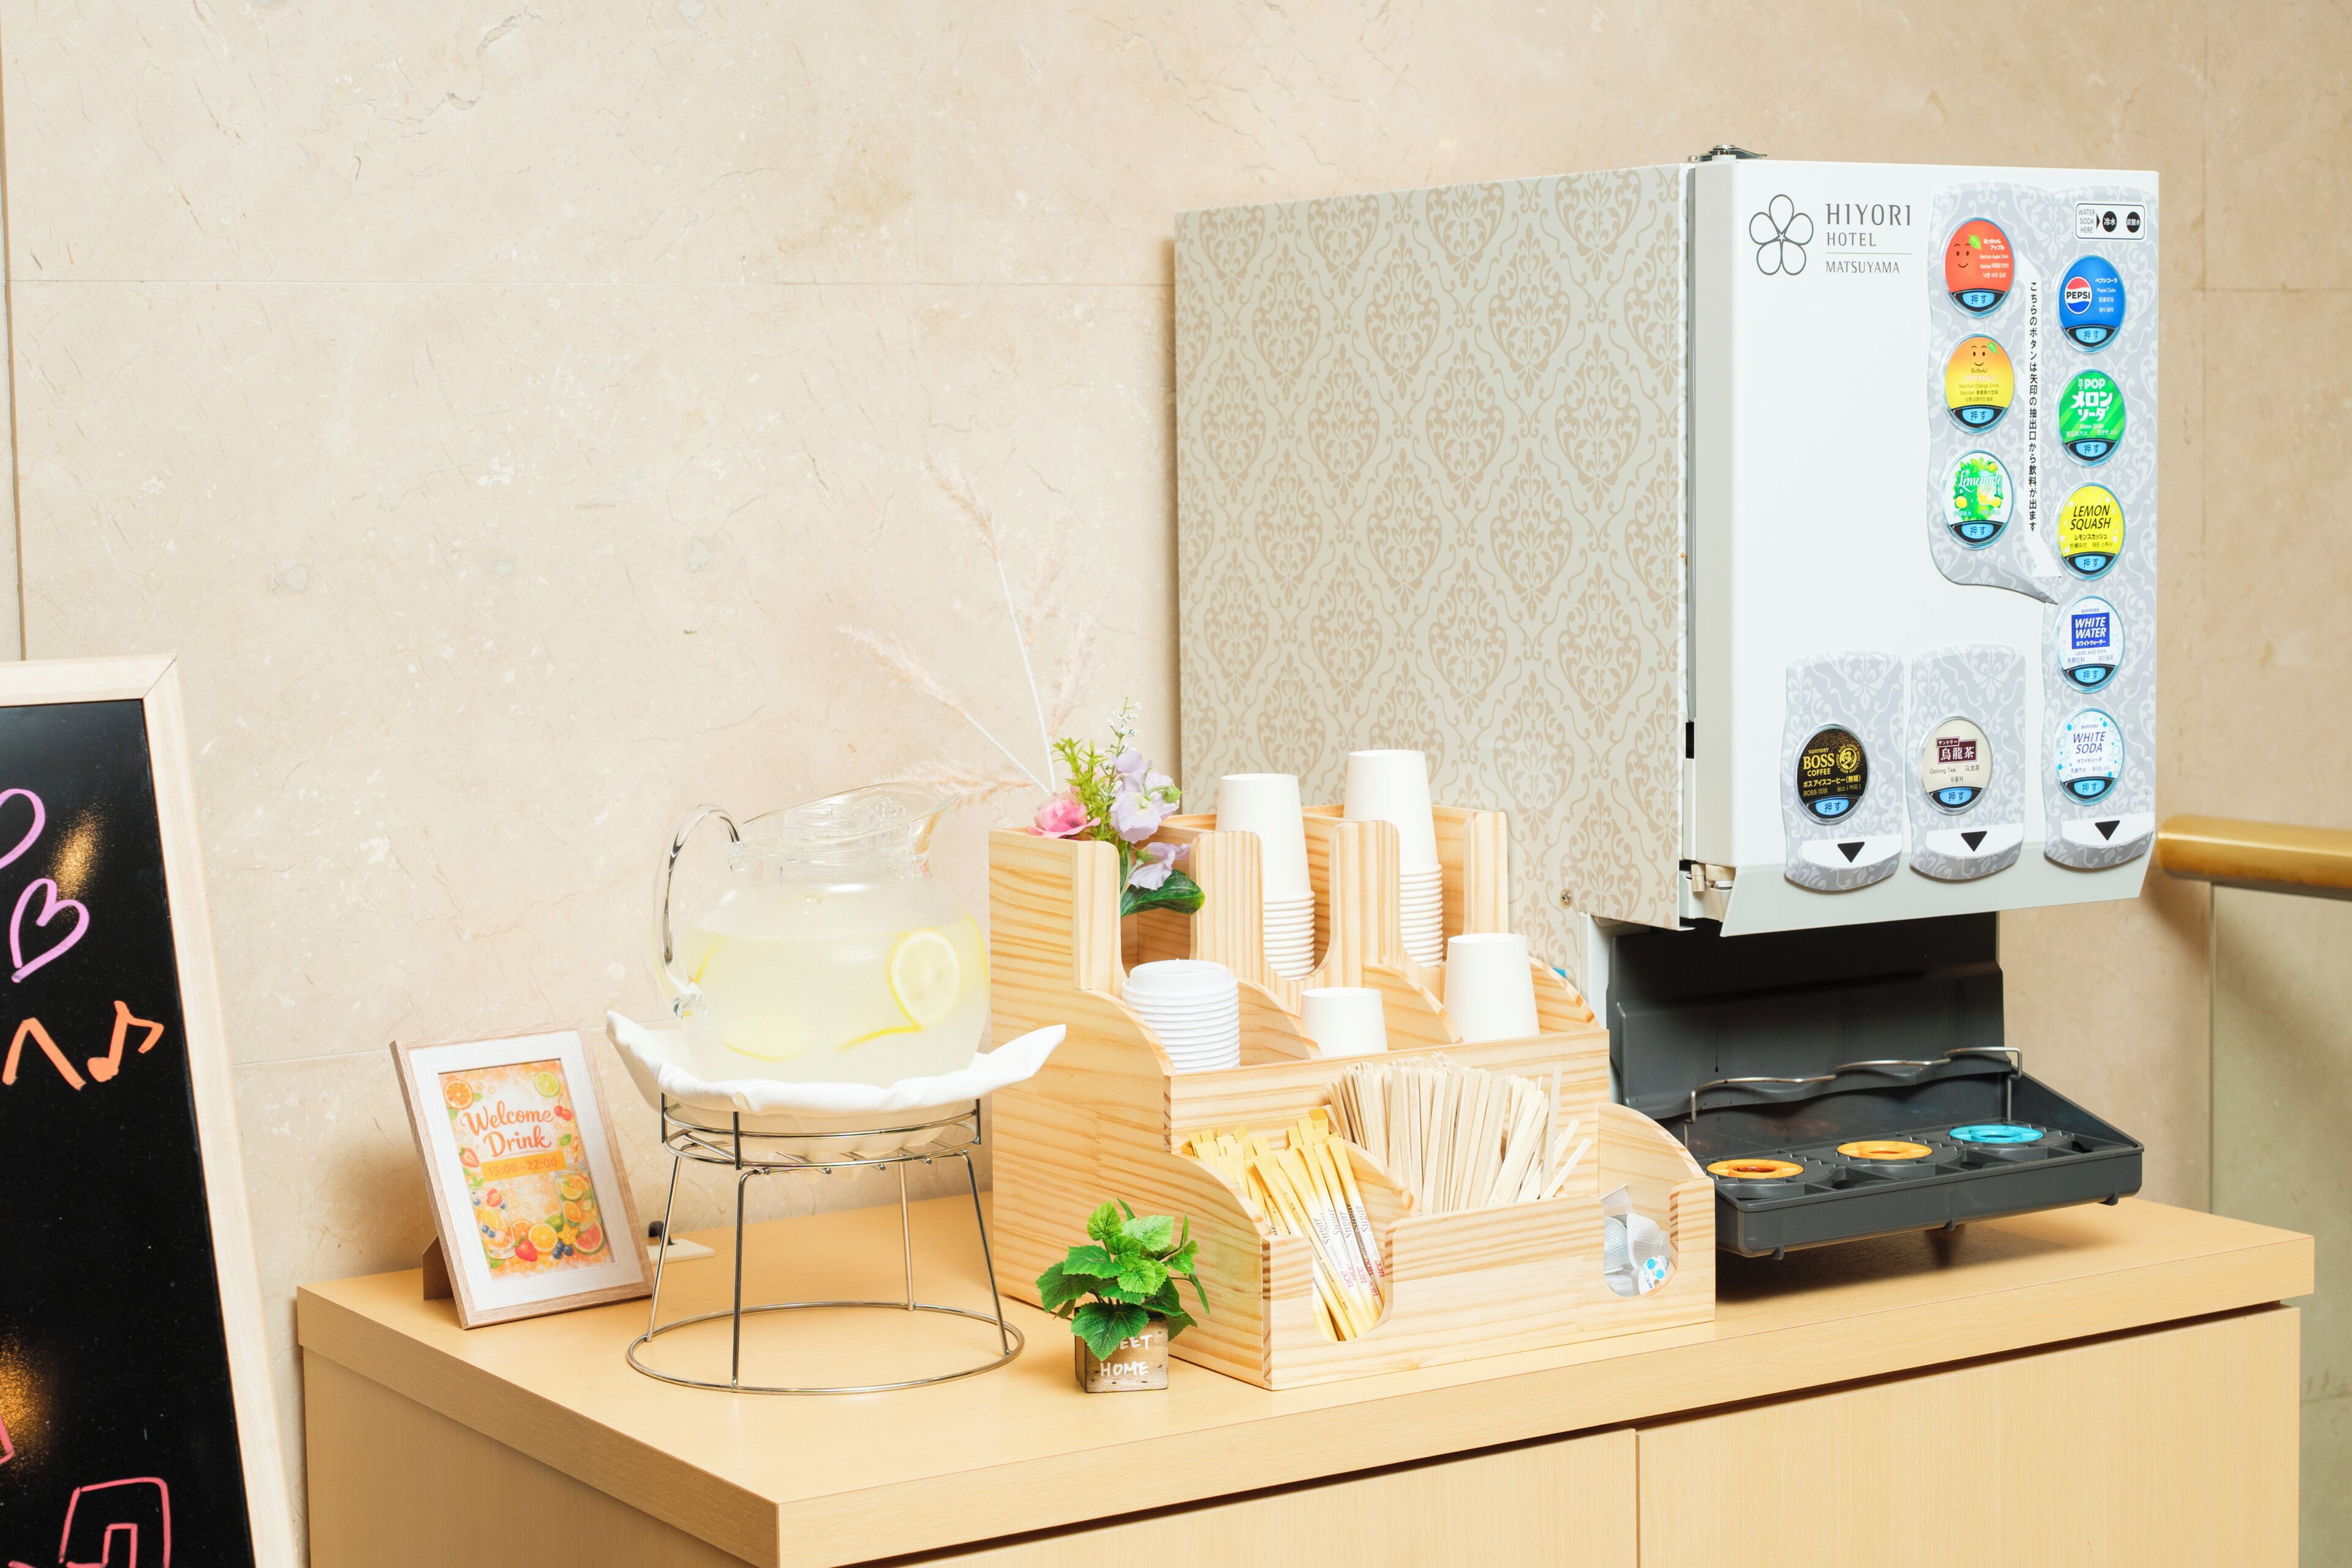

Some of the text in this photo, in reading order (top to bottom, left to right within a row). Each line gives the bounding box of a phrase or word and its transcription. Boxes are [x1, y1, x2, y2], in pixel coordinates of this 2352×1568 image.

[1825, 203, 1911, 225] HIYORI
[1827, 232, 1876, 246] HOTEL
[1826, 261, 1899, 273] MATSUYAMA
[1971, 295, 1987, 304] 押す
[2084, 331, 2099, 339] 押す
[2085, 378, 2105, 390] POP
[2071, 391, 2113, 409] メロン
[2029, 282, 2037, 532] こちらのボタンは矢印の抽出口から飲料が出ます
[1970, 411, 1986, 420] 押す
[2078, 406, 2109, 421] ソーダ
[2084, 444, 2099, 453] 押す
[2073, 505, 2109, 517] LEMON
[2070, 518, 2111, 530] SQUASH
[1970, 526, 1986, 535] 押す
[2084, 559, 2098, 568] 押す
[2075, 617, 2106, 628] WHITE
[2076, 628, 2106, 639] WATER
[2083, 671, 2098, 680] 押す
[2073, 731, 2105, 743] WHITE
[1941, 746, 1975, 760] 烏龍茶
[2076, 743, 2102, 754] SODA
[1803, 754, 1834, 769] BOSS
[1807, 768, 1831, 777] COFFEE
[2082, 783, 2097, 793] 押す
[1948, 792, 1964, 801] 押す
[1825, 802, 1841, 812] 押す
[460, 1100, 554, 1136] Welcome
[483, 1124, 552, 1158] Drink
[1340, 1211, 1354, 1238] Sugar
[1314, 1218, 1333, 1245] Sugar
[1120, 1335, 1153, 1351] EET
[1100, 1361, 1149, 1377] HOME
